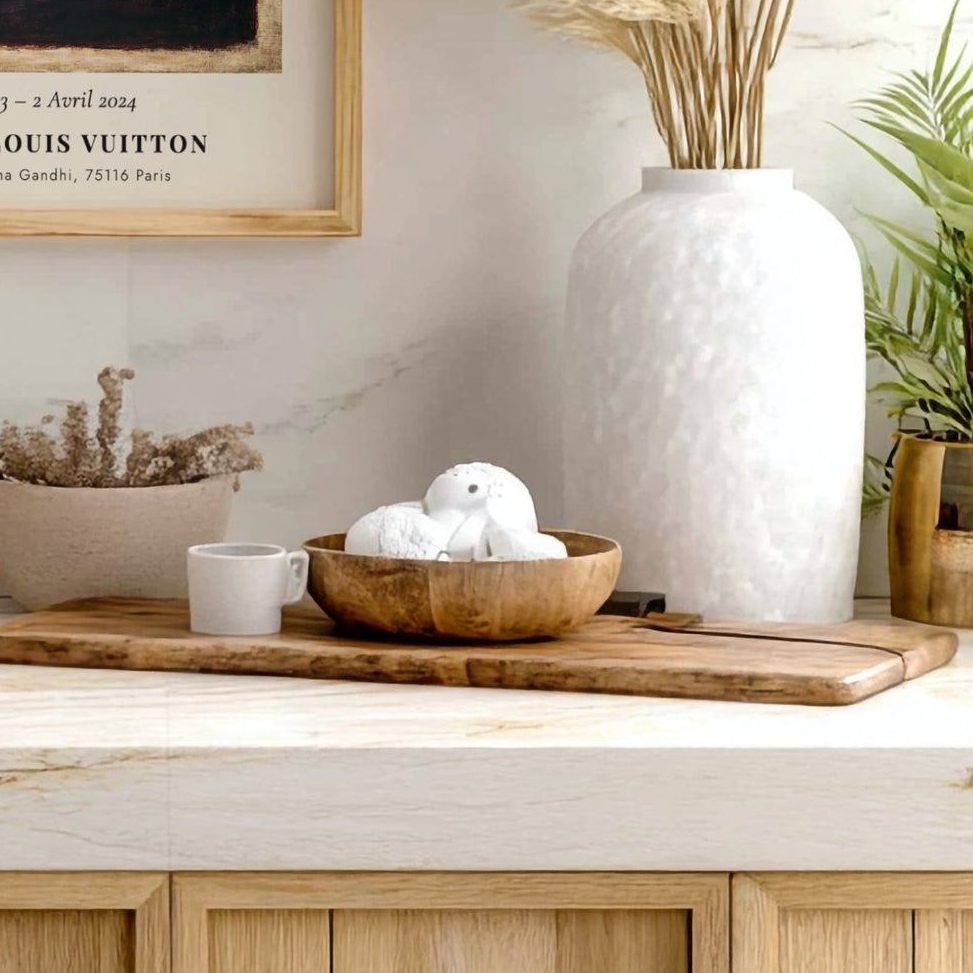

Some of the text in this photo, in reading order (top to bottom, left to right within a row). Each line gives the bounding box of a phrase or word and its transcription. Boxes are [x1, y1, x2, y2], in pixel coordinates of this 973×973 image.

[32, 96, 42, 108] 2
[46, 88, 94, 109] Avril
[98, 96, 137, 113] 2024
[80, 133, 208, 154] VUITTON
[18, 167, 78, 184] Gandhi,
[85, 168, 129, 182] 75116
[136, 168, 171, 182] Paris
